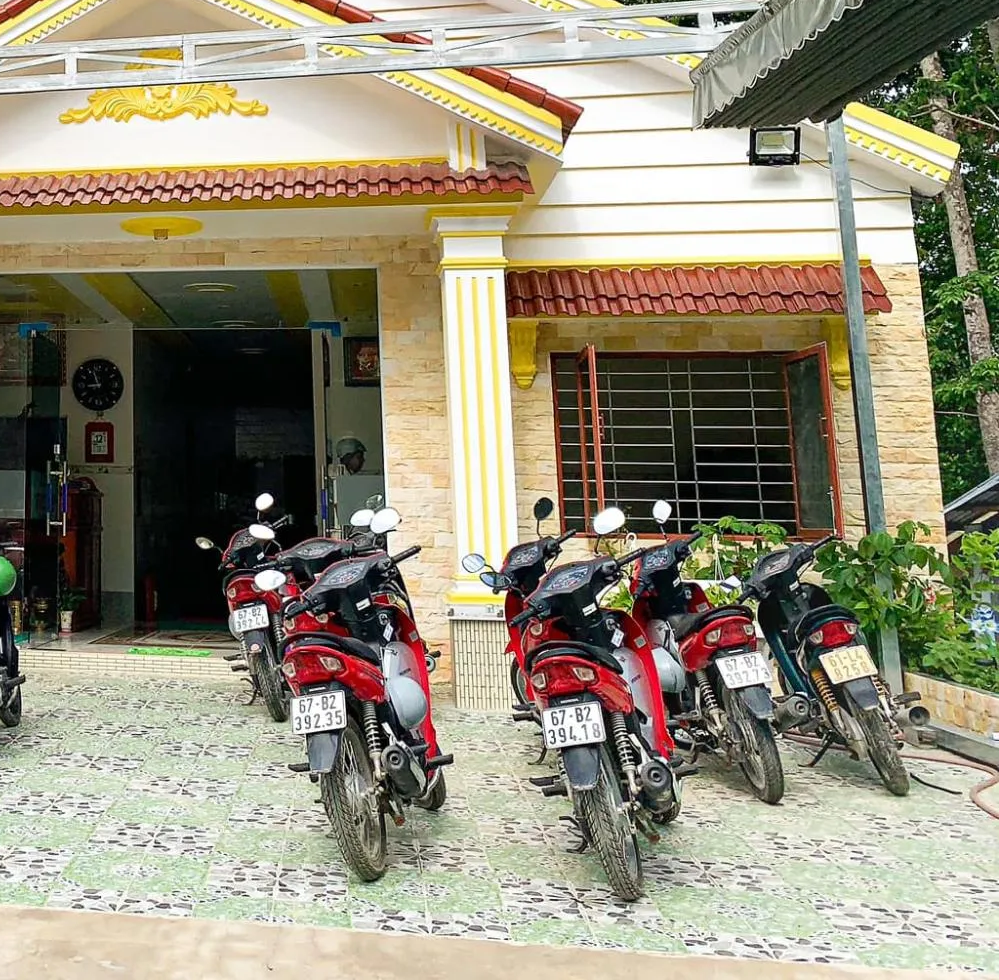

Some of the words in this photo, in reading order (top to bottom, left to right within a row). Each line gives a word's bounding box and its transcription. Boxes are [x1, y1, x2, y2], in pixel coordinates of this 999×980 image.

[299, 695, 336, 713] 67-B2
[295, 710, 343, 731] 392.35
[551, 706, 592, 726] 67-B2
[548, 723, 601, 745] 394.18
